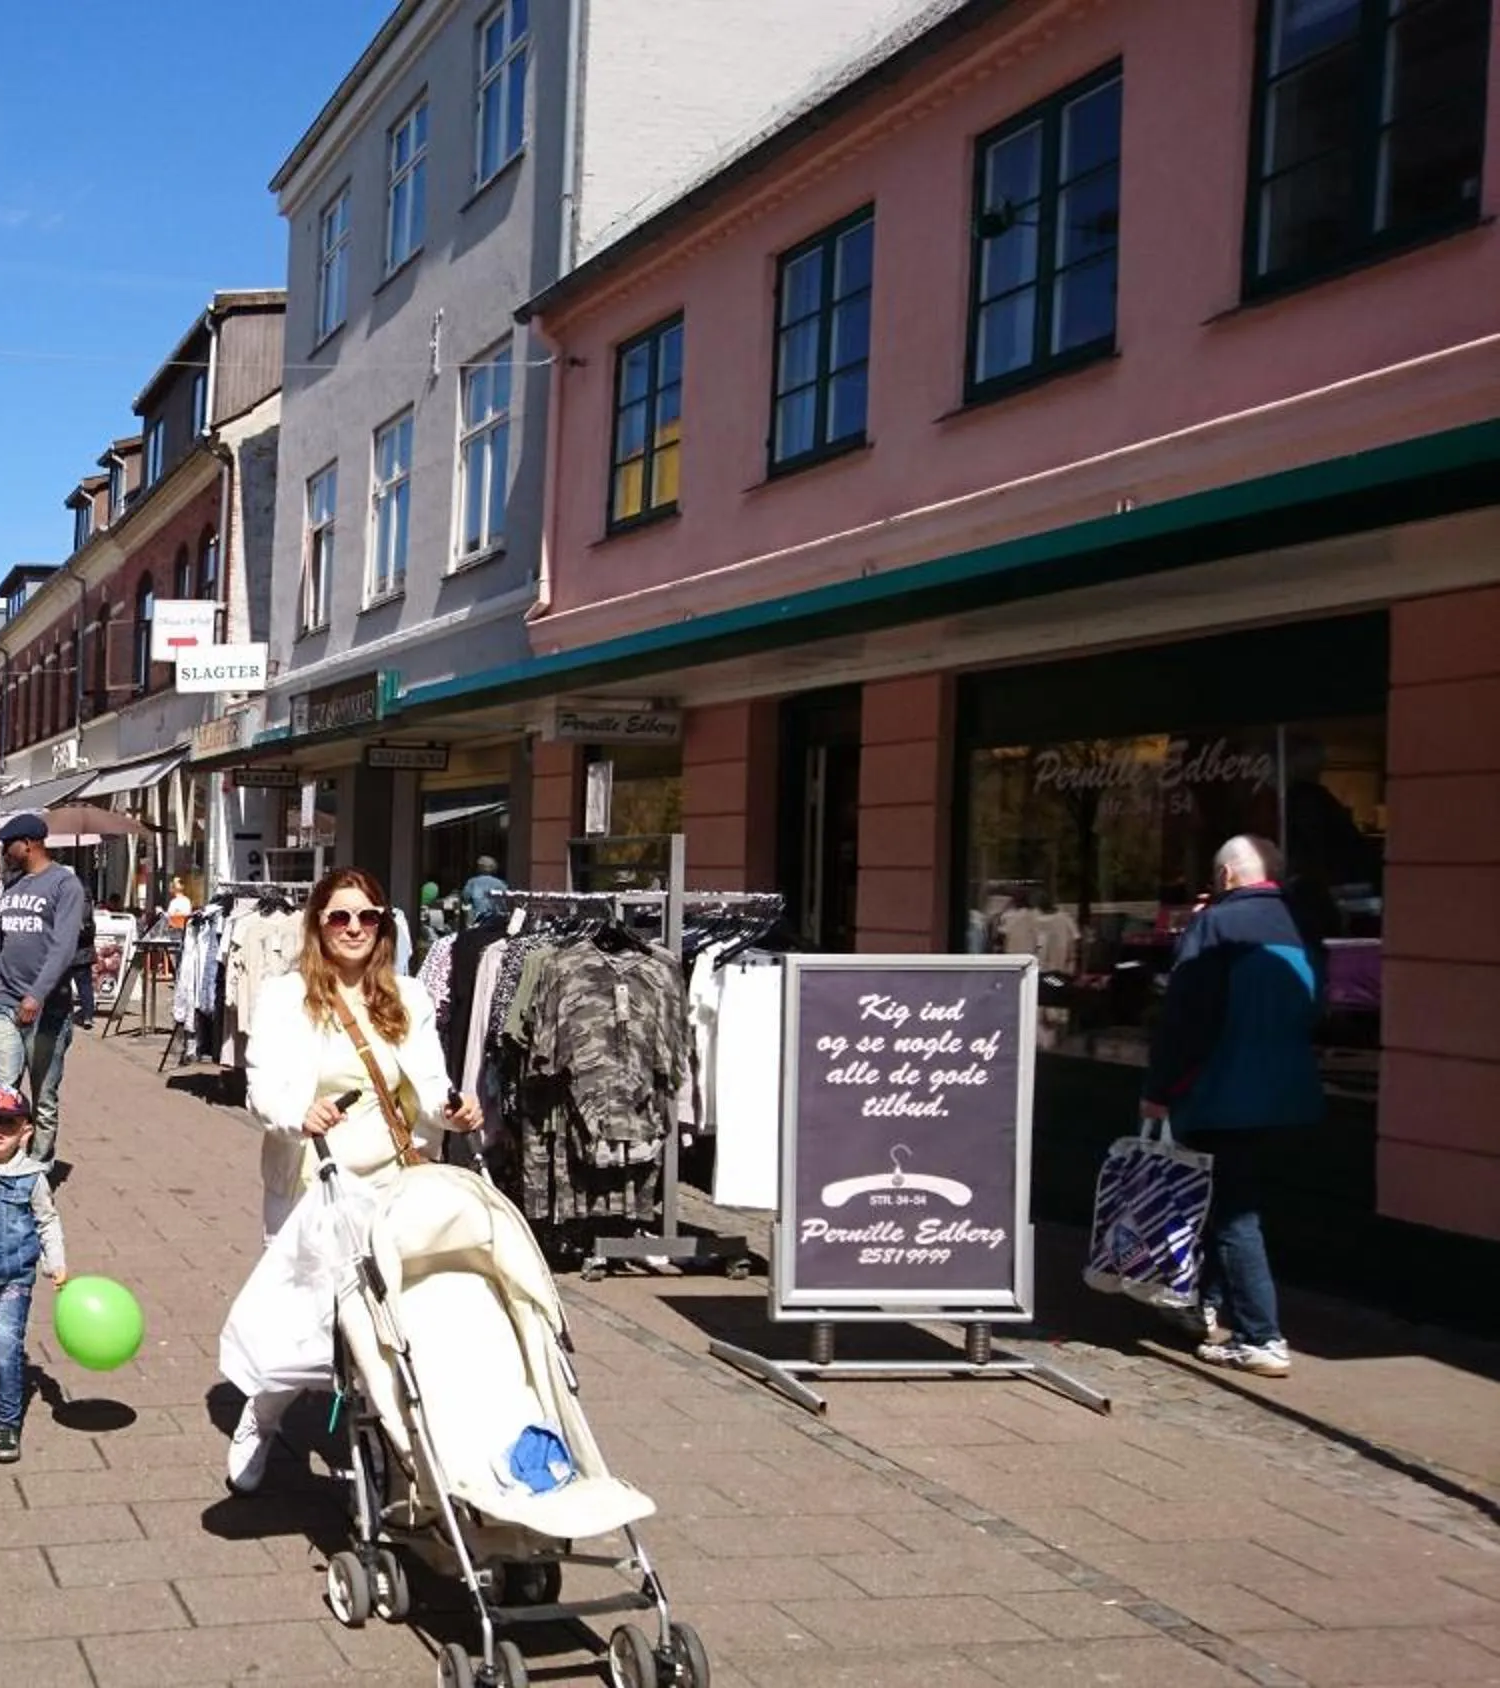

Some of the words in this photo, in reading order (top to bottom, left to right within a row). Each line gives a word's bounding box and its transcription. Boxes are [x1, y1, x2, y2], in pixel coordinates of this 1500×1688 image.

[181, 664, 260, 680] SLAGTER
[1032, 748, 1145, 794] Pernille
[1157, 737, 1274, 794] Edberg
[858, 993, 911, 1029] Kig
[919, 998, 966, 1021] ind
[816, 1035, 849, 1060] og
[855, 1036, 885, 1053] se
[893, 1030, 963, 1061] nogle
[969, 1030, 1001, 1061] af
[826, 1060, 880, 1084] alle
[888, 1061, 921, 1084] de
[929, 1062, 988, 1093] gode
[861, 1092, 949, 1117] tilbud.
[800, 1217, 905, 1244] Pernille
[914, 1218, 1006, 1249] Edberg
